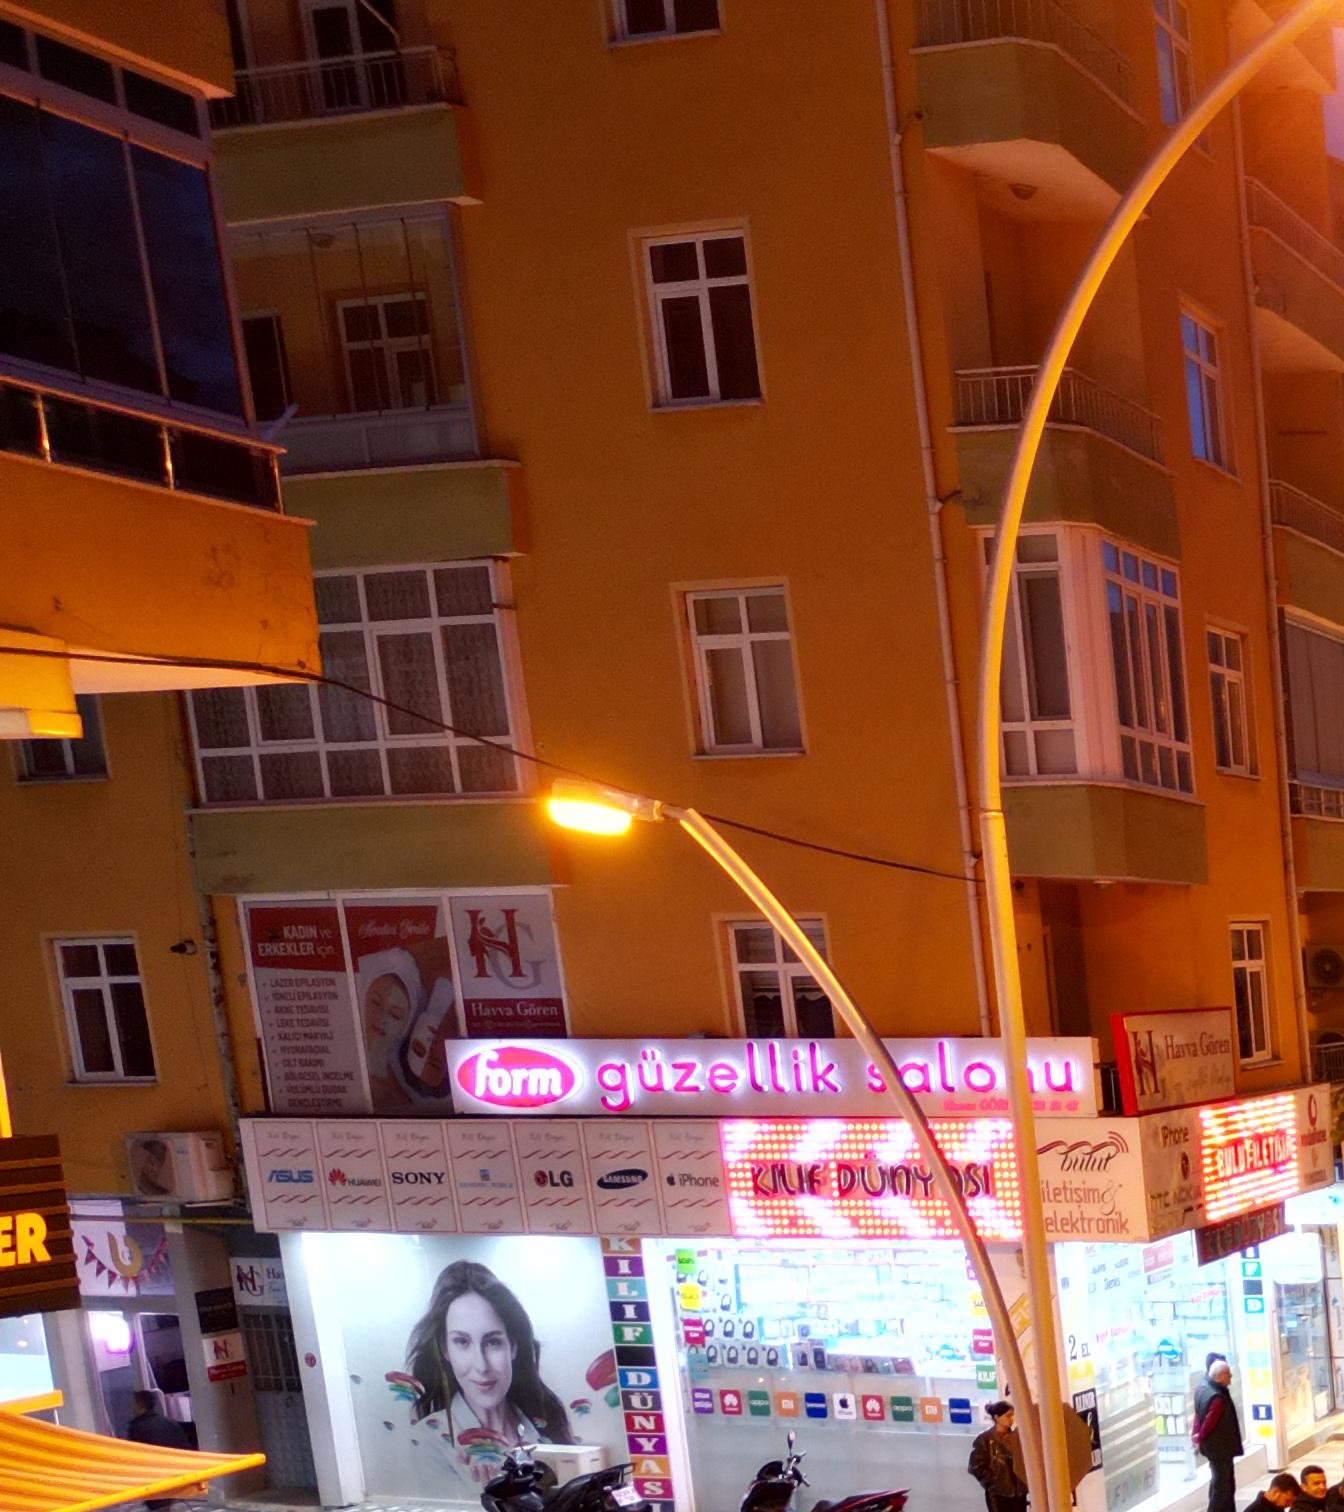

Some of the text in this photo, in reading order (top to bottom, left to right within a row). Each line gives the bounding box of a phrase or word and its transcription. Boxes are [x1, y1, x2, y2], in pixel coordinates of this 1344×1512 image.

[283, 925, 318, 939] KADIN
[257, 942, 316, 957] ERKEKLER
[471, 1001, 559, 1017] Havva Gören
[475, 1050, 562, 1097] form
[597, 1042, 842, 1112] güzellik
[267, 1170, 314, 1184] ASUS
[347, 1177, 382, 1187] HUAWEI
[391, 1171, 446, 1185] SONY
[549, 1170, 574, 1188] LG
[603, 1172, 644, 1184] SAMSUNG
[678, 1172, 720, 1187] iPhone
[752, 1163, 823, 1197] KILIF
[1041, 1180, 1100, 1208] iletişim
[1045, 1209, 1130, 1235] elektronik
